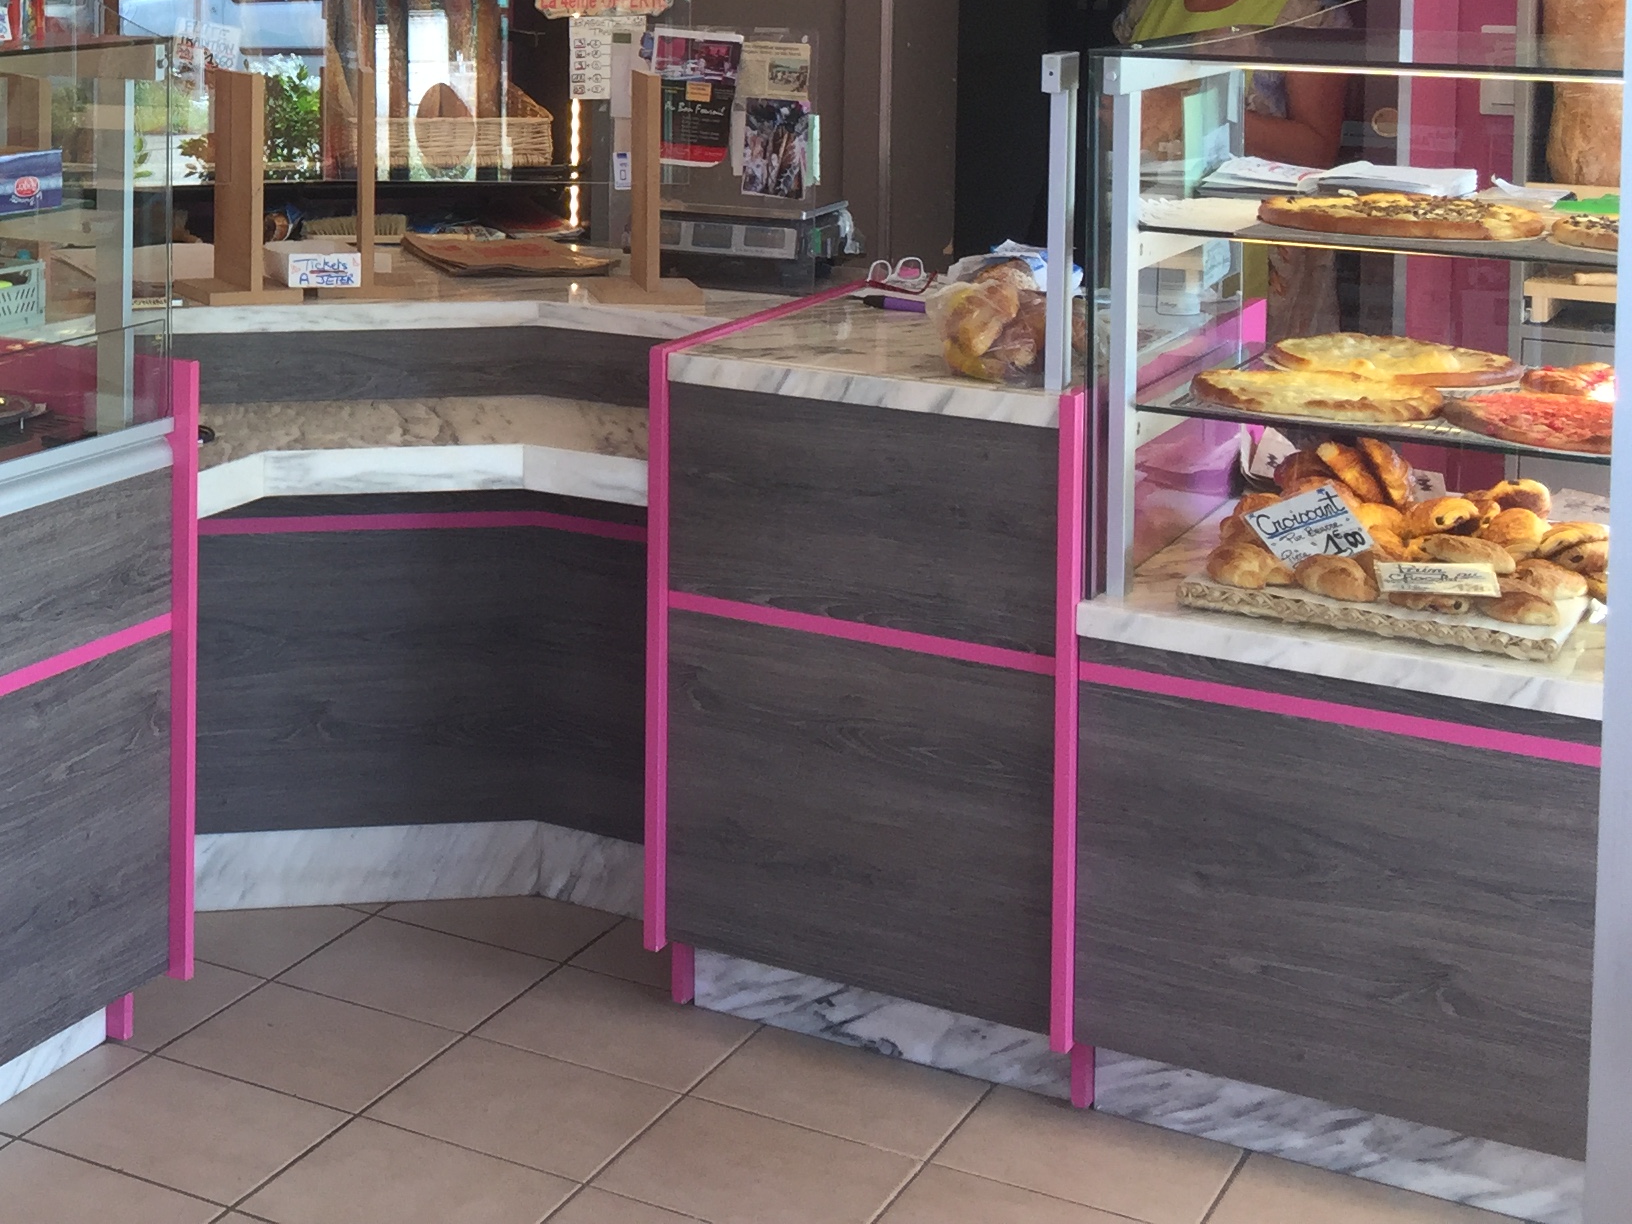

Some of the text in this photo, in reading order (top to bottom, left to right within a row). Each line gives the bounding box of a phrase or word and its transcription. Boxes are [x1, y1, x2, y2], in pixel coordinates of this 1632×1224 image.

[293, 257, 348, 272] Tickets
[299, 274, 355, 286] A JETER
[1255, 491, 1347, 537] Croissant
